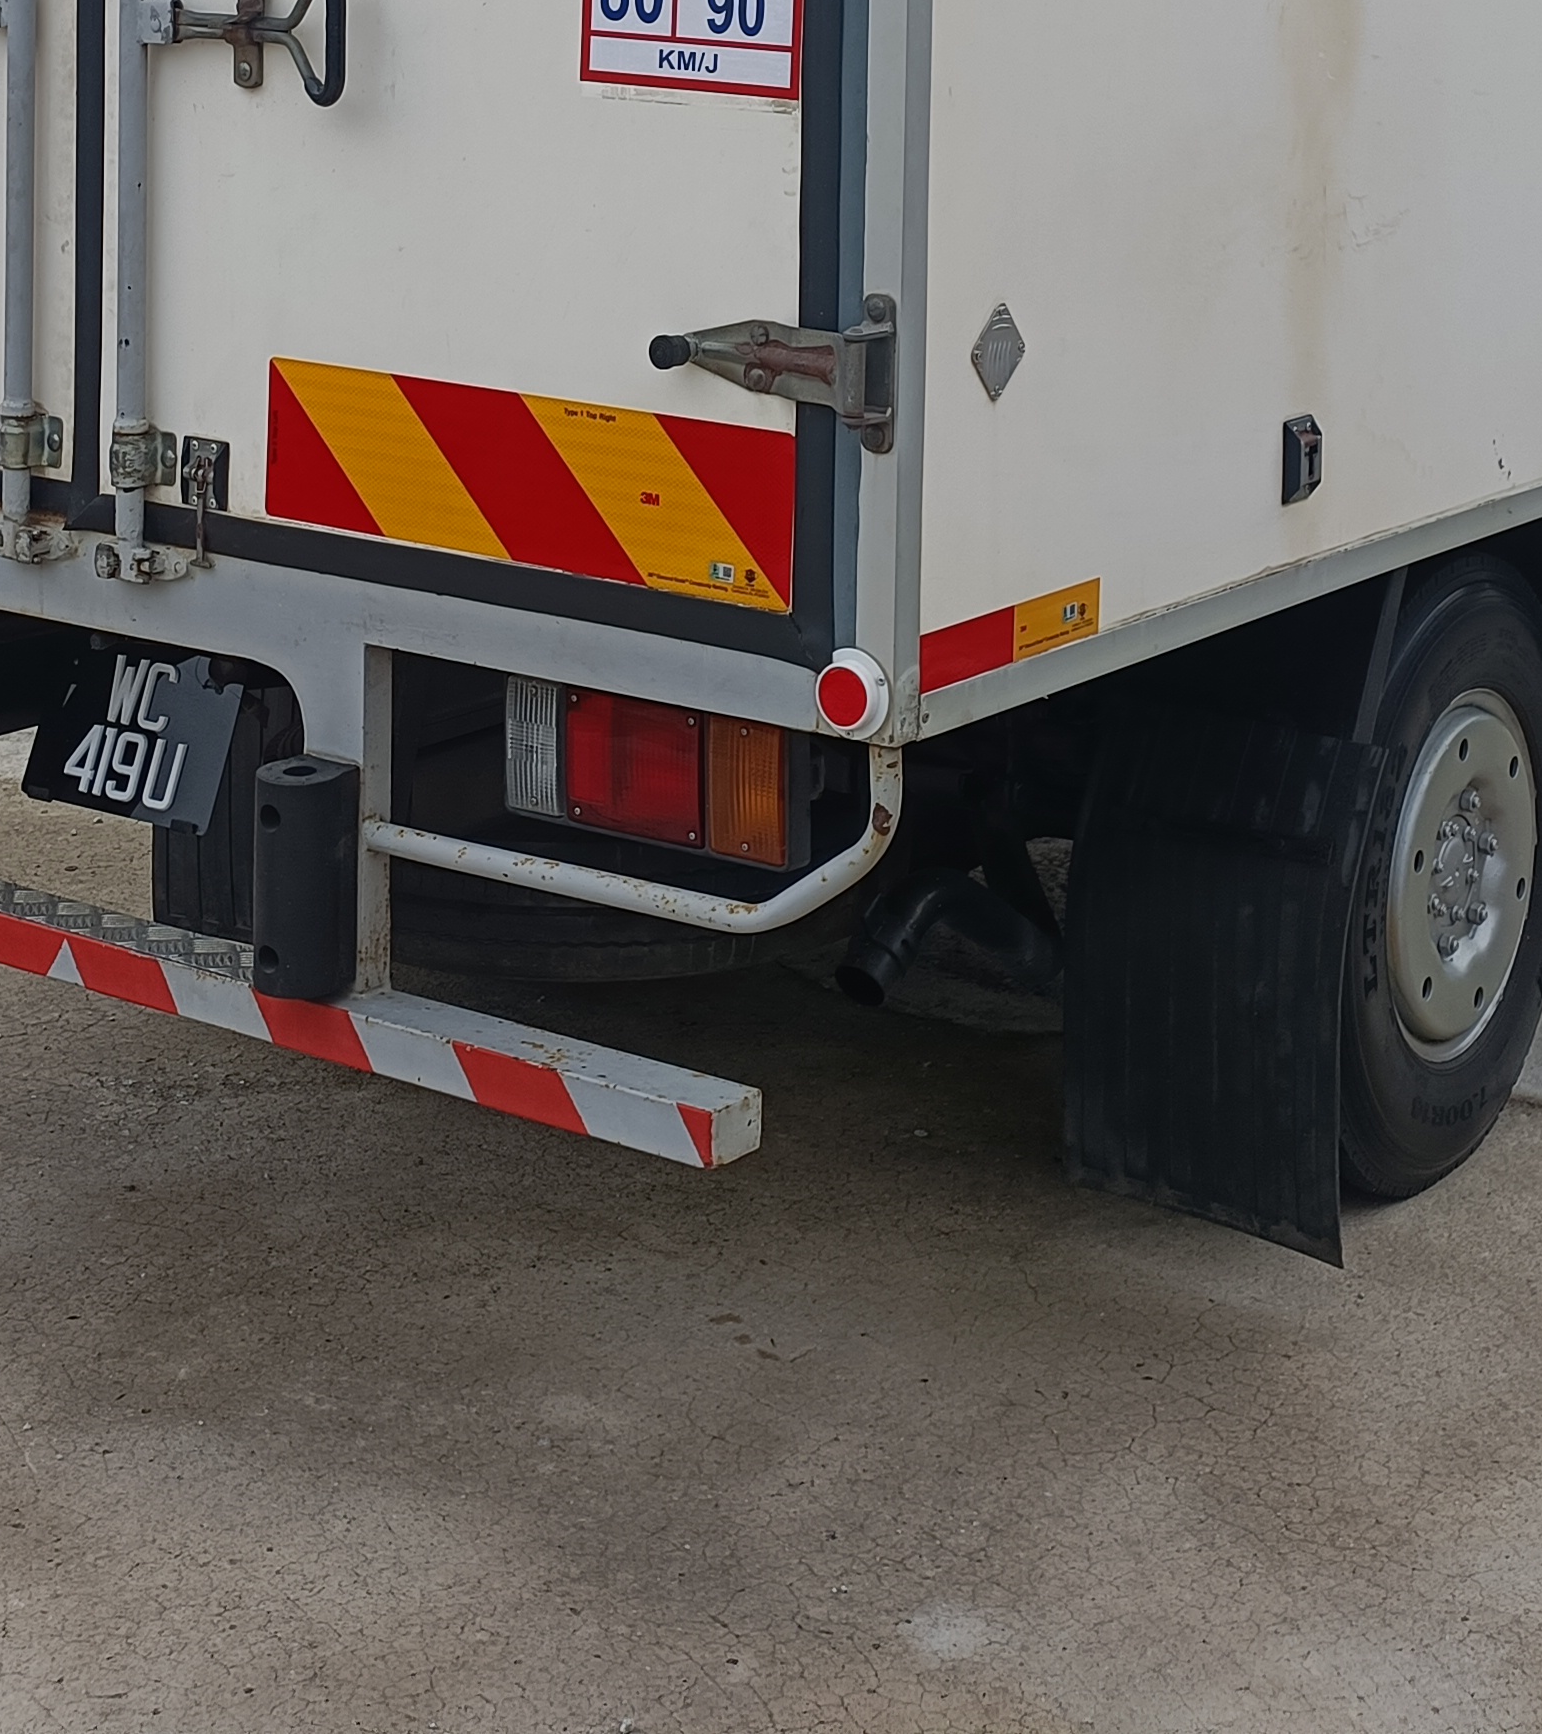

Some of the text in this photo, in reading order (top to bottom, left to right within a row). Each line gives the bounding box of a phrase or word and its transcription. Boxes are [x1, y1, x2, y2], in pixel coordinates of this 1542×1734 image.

[658, 49, 719, 74] KM/J
[564, 407, 578, 417] Type
[599, 412, 617, 423] Right
[640, 491, 660, 506] 3M
[107, 654, 180, 732] WC
